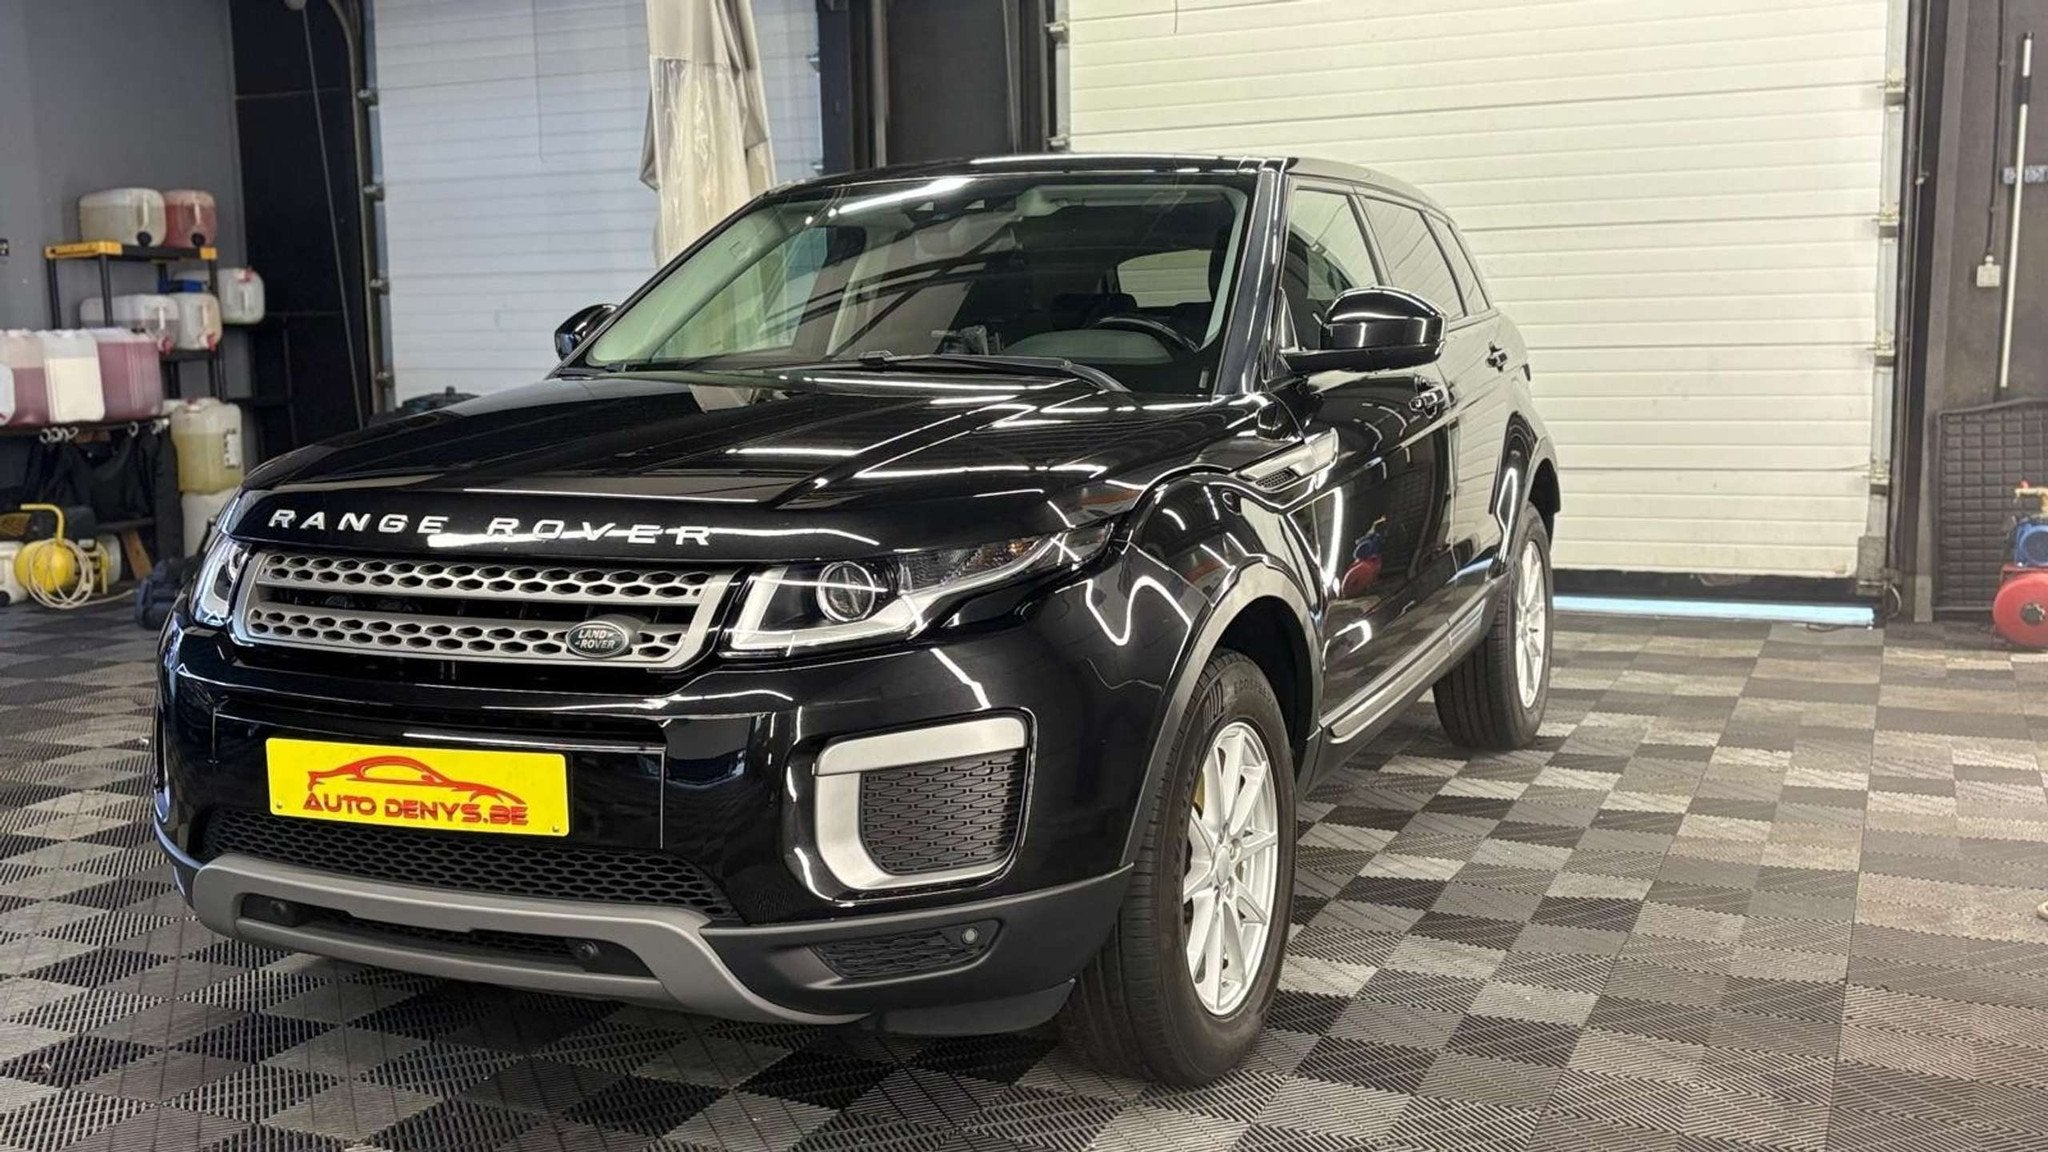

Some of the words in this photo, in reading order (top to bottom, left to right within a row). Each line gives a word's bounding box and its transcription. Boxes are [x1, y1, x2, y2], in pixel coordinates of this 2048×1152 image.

[267, 509, 449, 535] RANGE
[485, 516, 711, 547] ROVER
[578, 629, 607, 639] LAND
[579, 639, 616, 650] ROVER
[303, 792, 377, 816] AUTO
[384, 798, 528, 826] DENYS.BE
